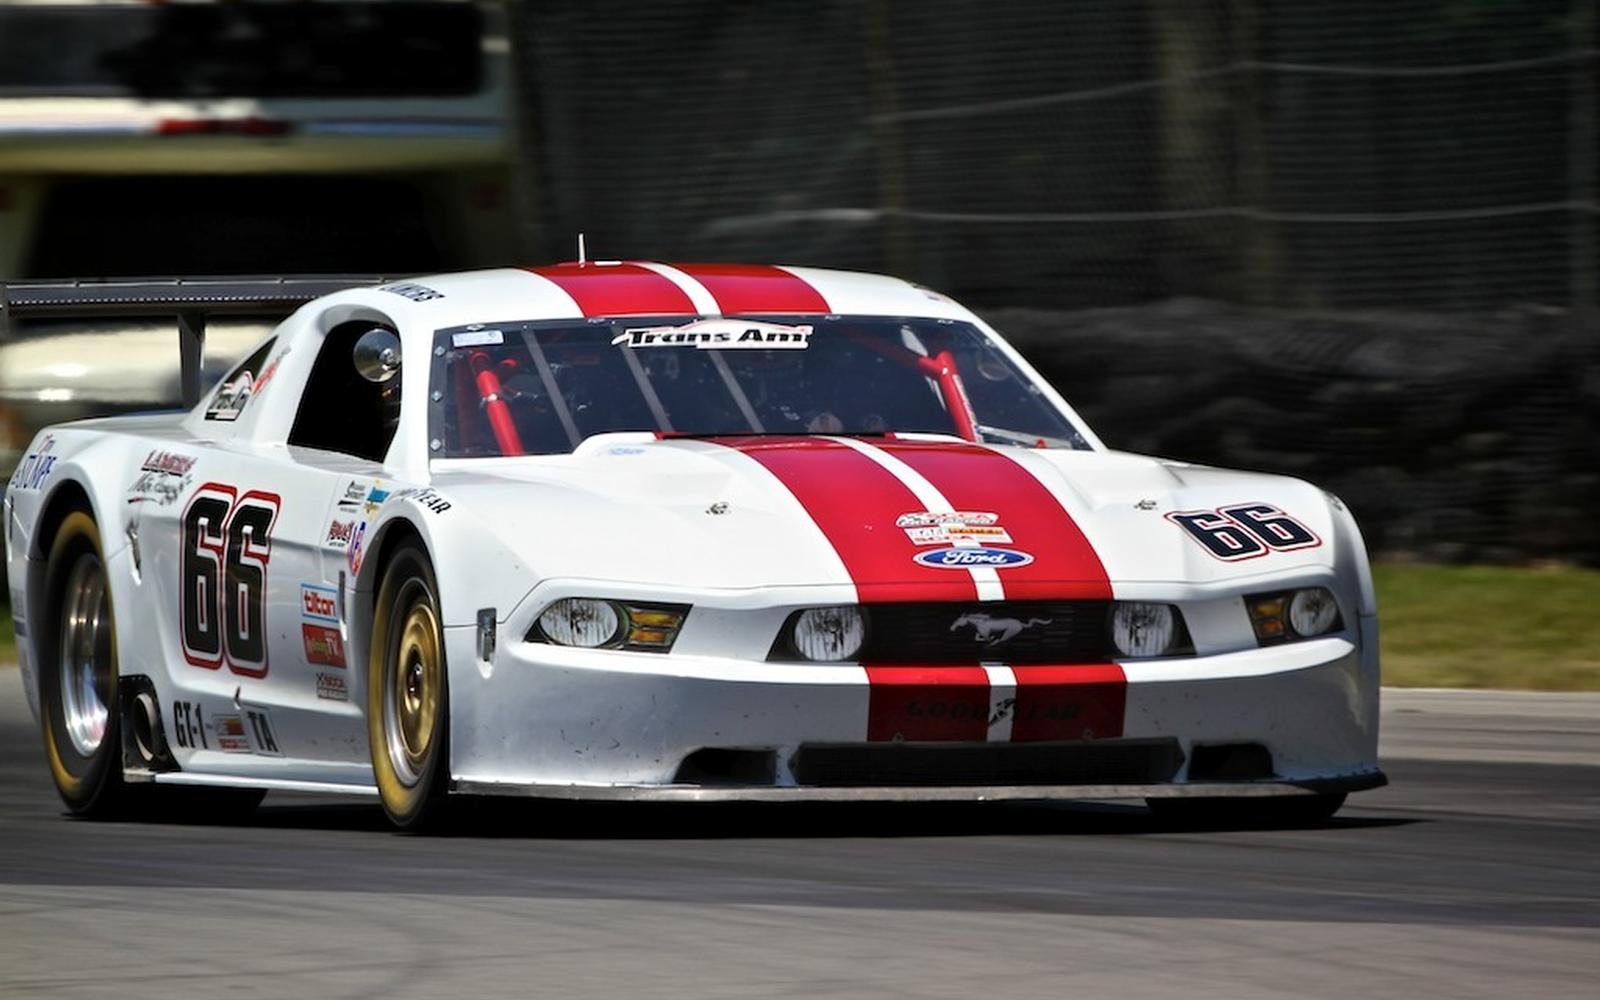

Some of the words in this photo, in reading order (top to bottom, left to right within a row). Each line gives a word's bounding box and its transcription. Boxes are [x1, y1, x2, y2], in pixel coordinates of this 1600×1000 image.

[630, 330, 731, 345] Trans
[737, 329, 811, 343] Am
[941, 550, 1008, 564] Ford
[1164, 502, 1322, 562] 66
[180, 483, 281, 679] 66
[173, 701, 208, 750] GT-1
[247, 711, 279, 753] TA
